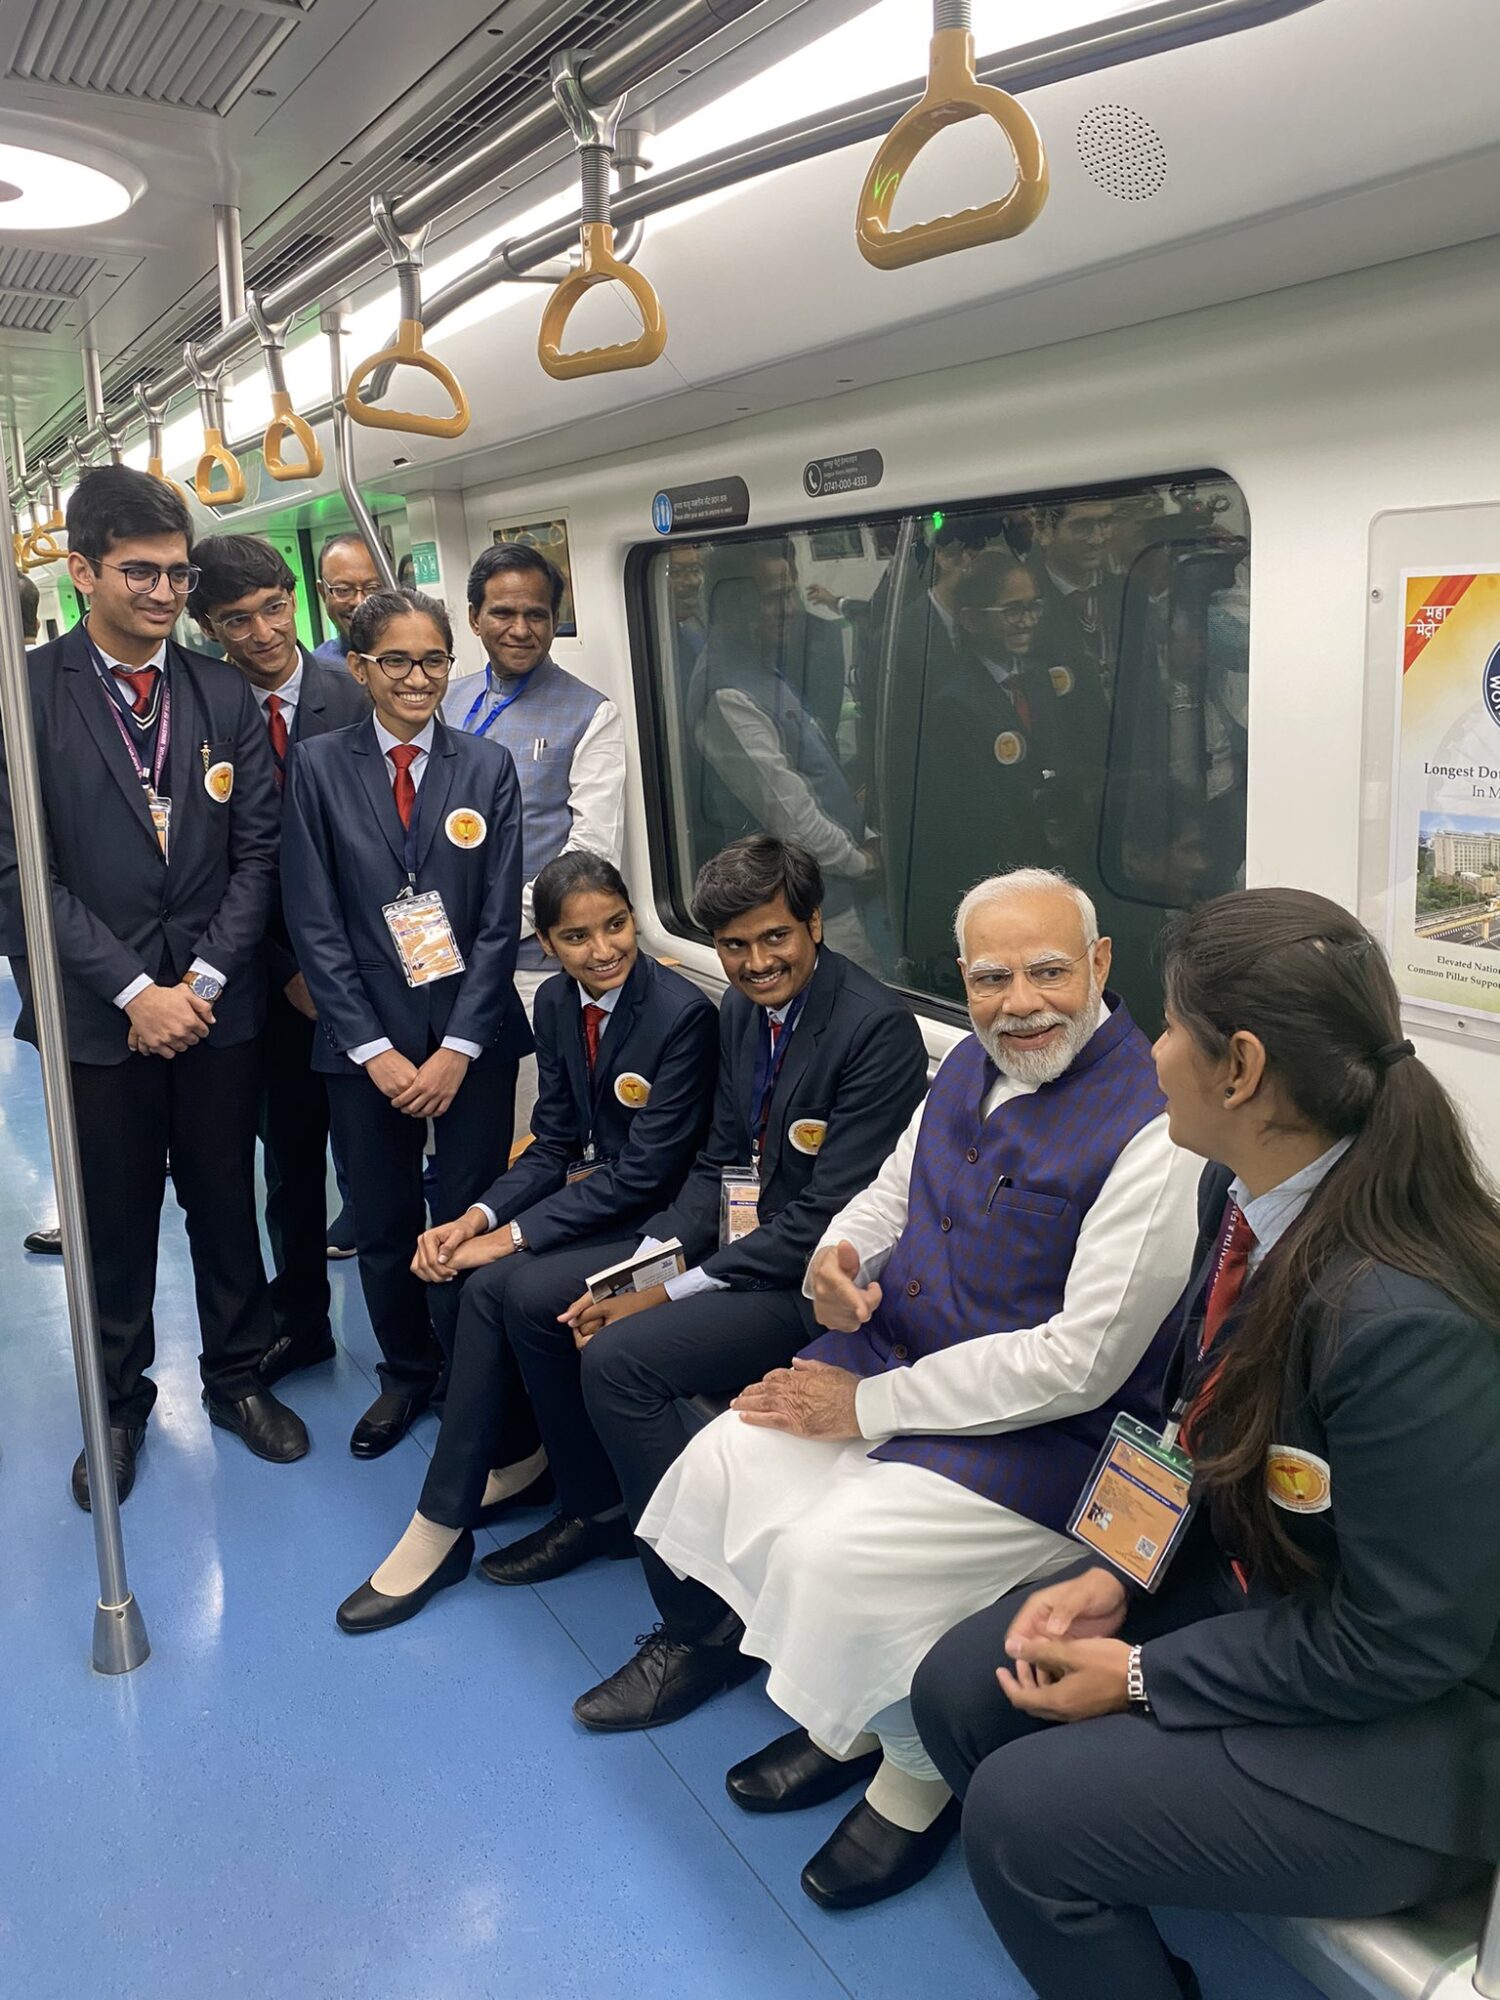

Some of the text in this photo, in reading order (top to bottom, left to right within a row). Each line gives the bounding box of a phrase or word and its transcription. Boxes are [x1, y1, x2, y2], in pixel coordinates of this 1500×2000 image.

[1422, 605, 1449, 620] महा
[1412, 618, 1437, 639] मेट्रो
[1424, 762, 1474, 779] Longest
[1472, 784, 1485, 797] In
[1437, 955, 1472, 969] Elevated
[1407, 963, 1444, 978] Common
[1446, 971, 1468, 983] Pillar
